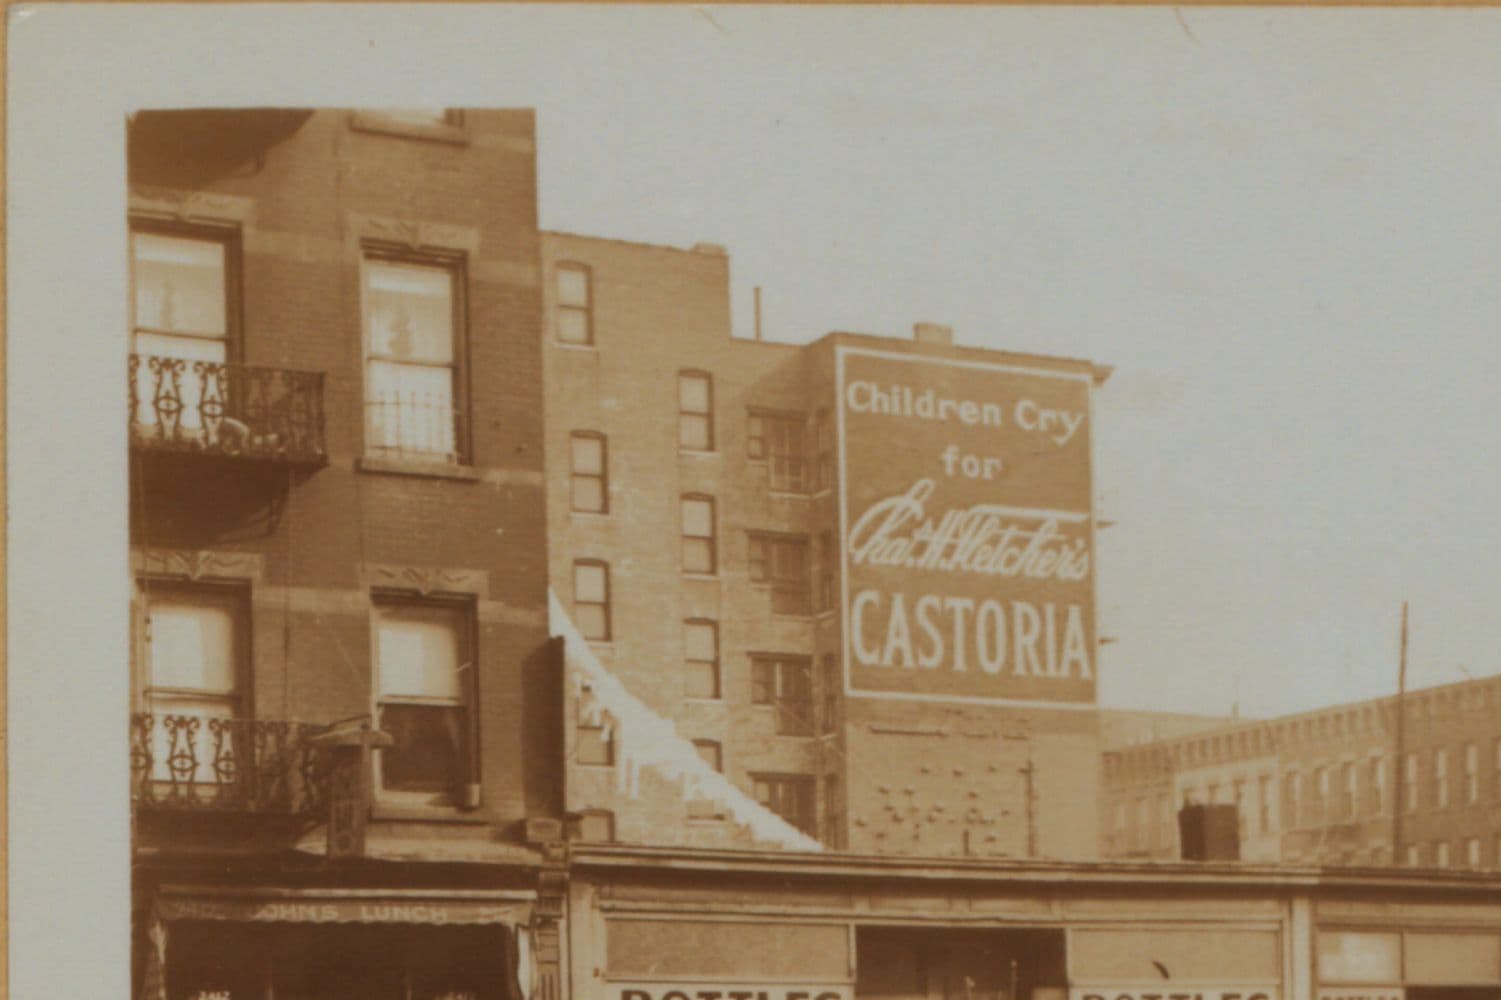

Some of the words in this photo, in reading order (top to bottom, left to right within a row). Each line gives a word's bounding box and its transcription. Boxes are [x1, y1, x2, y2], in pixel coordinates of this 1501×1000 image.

[847, 380, 1002, 426] Children
[1014, 399, 1085, 446] Cry
[941, 445, 1003, 480] for
[853, 589, 1093, 680] CASTORIA
[360, 905, 448, 924] LUNCH
